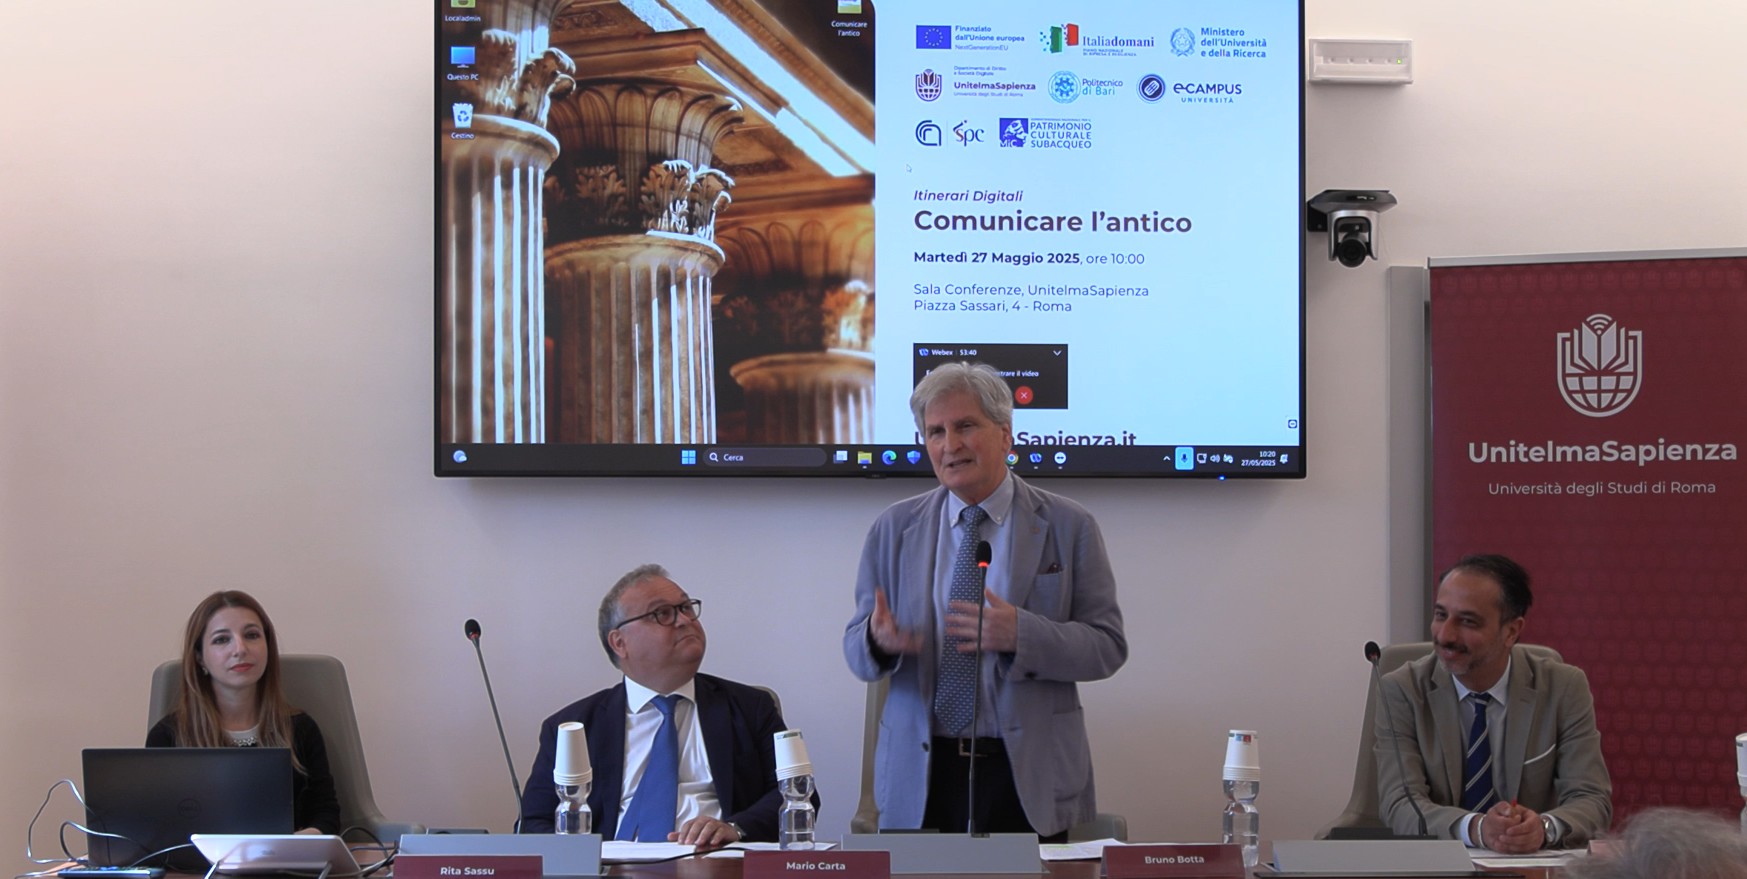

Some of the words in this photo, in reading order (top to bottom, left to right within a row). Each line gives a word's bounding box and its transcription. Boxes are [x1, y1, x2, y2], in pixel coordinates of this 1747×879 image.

[831, 20, 868, 28] Comunicare
[955, 25, 992, 33] Finanziato
[1200, 27, 1245, 37] Ministero
[955, 34, 994, 42] dall'Unione
[1083, 35, 1155, 47] Italiadomani
[1200, 38, 1267, 48] dell'Università
[1208, 49, 1231, 58] della
[1233, 49, 1267, 58] Ricerca
[447, 73, 469, 81] Questo
[470, 73, 479, 81] PC
[954, 82, 1036, 91] UnitelmaSapienza
[1082, 78, 1123, 87] Politecnico
[1082, 86, 1092, 95] di
[1096, 87, 1115, 96] Bari
[1030, 122, 1092, 131] PATRIMONIO
[1030, 131, 1092, 140] CULTURALE
[1030, 140, 1092, 150] SUBACQUEO
[914, 190, 969, 202] Itinerari
[973, 190, 1023, 204] Digitali
[914, 210, 1083, 232] Comunicare
[914, 252, 968, 263] Martedì
[971, 252, 987, 263] 27
[992, 253, 1043, 266] Maggio
[1047, 252, 1083, 265] 2025,
[1086, 256, 1107, 264] ore
[1111, 253, 1145, 265] 10:00
[914, 284, 940, 295] Sala
[945, 284, 1024, 297] Conferenze,
[1028, 285, 1149, 298] UnitelmaSapienza
[914, 300, 956, 311] Piazza
[960, 300, 1008, 313] Sassari,
[1012, 300, 1020, 311] 4
[1033, 300, 1072, 312] Roma
[1468, 438, 1738, 466] UnitelmaSapienza
[723, 453, 744, 462] Cerca
[1488, 482, 1562, 495] Università
[1566, 481, 1603, 496] degli
[1607, 481, 1648, 494] Studi
[1652, 481, 1666, 493] di
[1670, 481, 1716, 494] Roma
[1145, 856, 1175, 864] Bruno
[1177, 855, 1205, 864] Botta
[786, 861, 816, 870] Mario
[818, 862, 846, 870] Carta
[440, 866, 461, 875] Rita
[464, 867, 495, 875] Sassu
